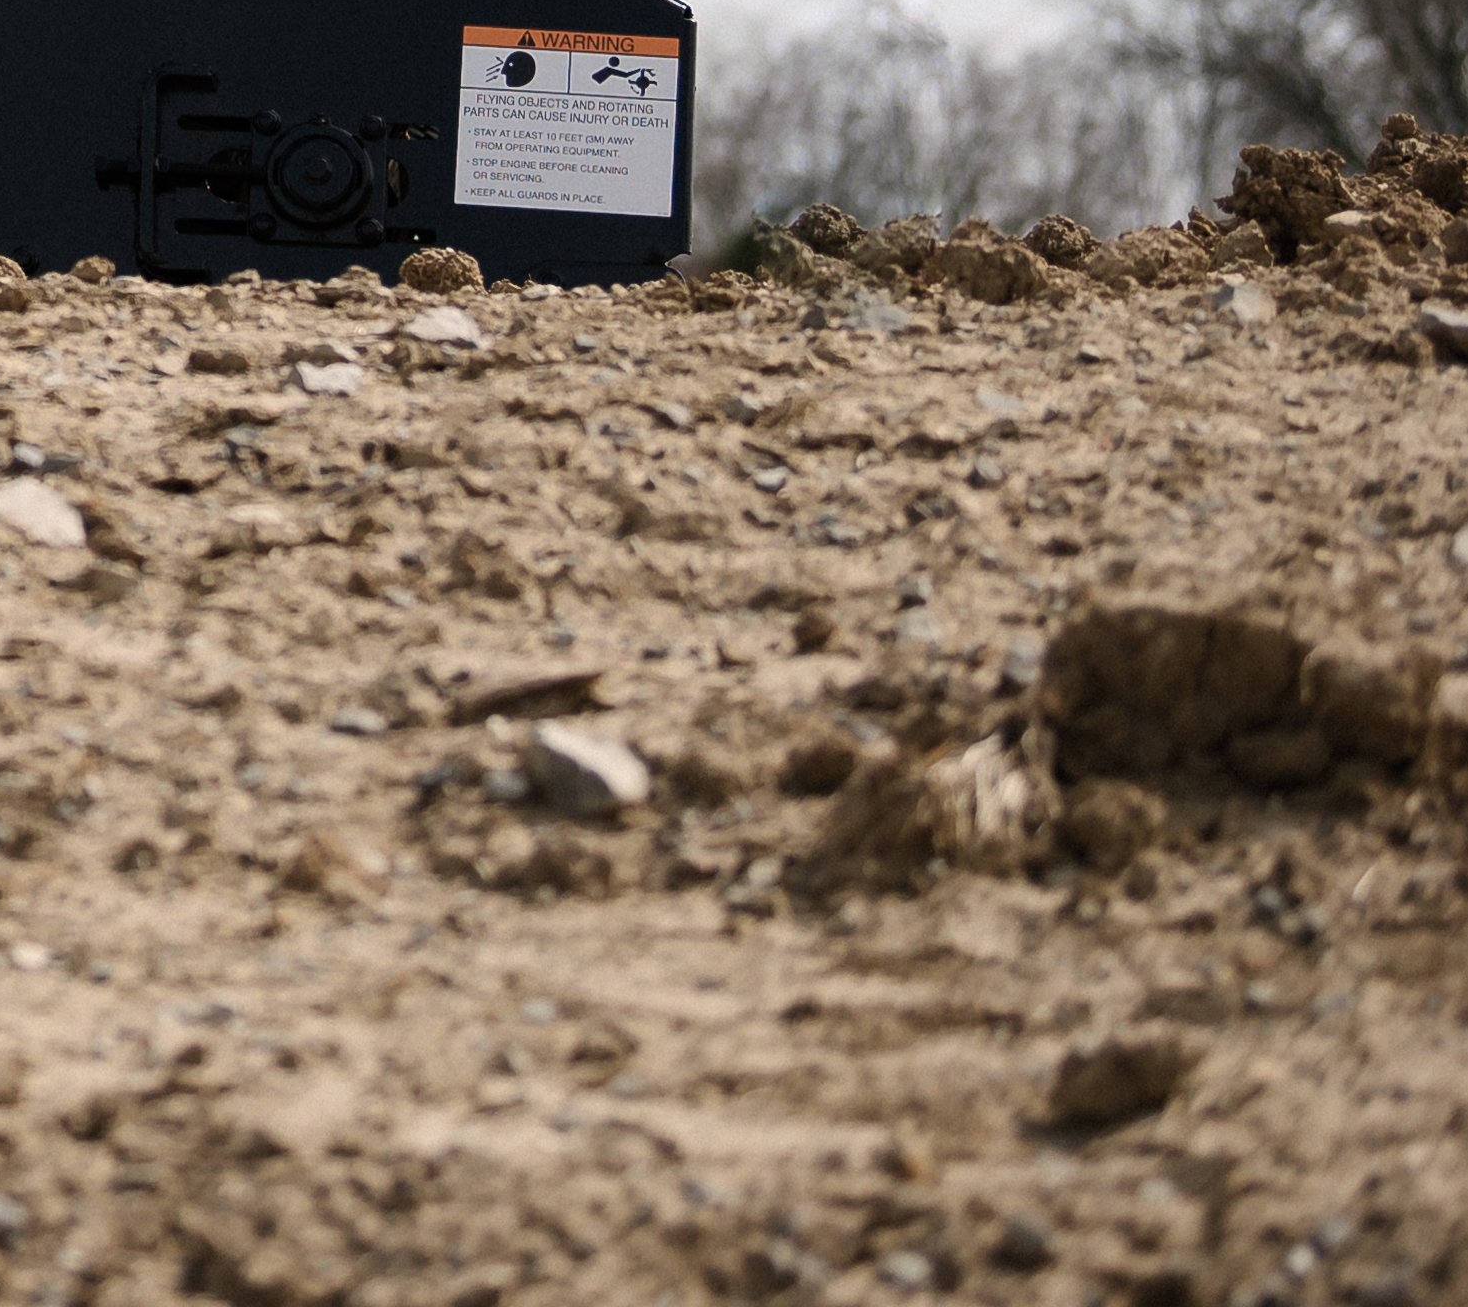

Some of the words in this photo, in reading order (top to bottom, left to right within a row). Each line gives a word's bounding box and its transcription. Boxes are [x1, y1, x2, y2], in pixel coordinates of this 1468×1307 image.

[541, 32, 635, 52] WARNING
[476, 94, 515, 106] FLYING
[518, 96, 569, 109] OBJECTS
[572, 100, 595, 111] AND
[598, 101, 654, 114] ROTATING
[463, 106, 499, 118] PARTS
[502, 108, 525, 120] CAN
[528, 110, 567, 122] CAUSE
[569, 113, 609, 125] INJURY
[612, 115, 629, 126] OR
[631, 116, 669, 128] DEATH
[473, 128, 497, 137] STAY
[499, 130, 511, 138] AT
[513, 130, 543, 140] LEAST
[546, 132, 557, 141] 10
[559, 133, 583, 142] FEET
[585, 135, 605, 145] (3M)
[607, 136, 635, 146] AWAY
[475, 141, 503, 150] FROM
[505, 143, 560, 154] OPERATING
[562, 146, 620, 158] EQUIPMENT.
[471, 158, 498, 167] STOP
[500, 160, 537, 170] ENGINE
[539, 162, 578, 172] BEFORE
[580, 164, 629, 175] CLEANING
[473, 171, 488, 180] OR
[490, 172, 544, 183] SERVICING.
[470, 188, 496, 197] KEEP
[497, 189, 514, 198] ALL
[517, 190, 558, 201] GUARDS
[560, 193, 570, 201] IN
[572, 194, 606, 204] PLACE.
